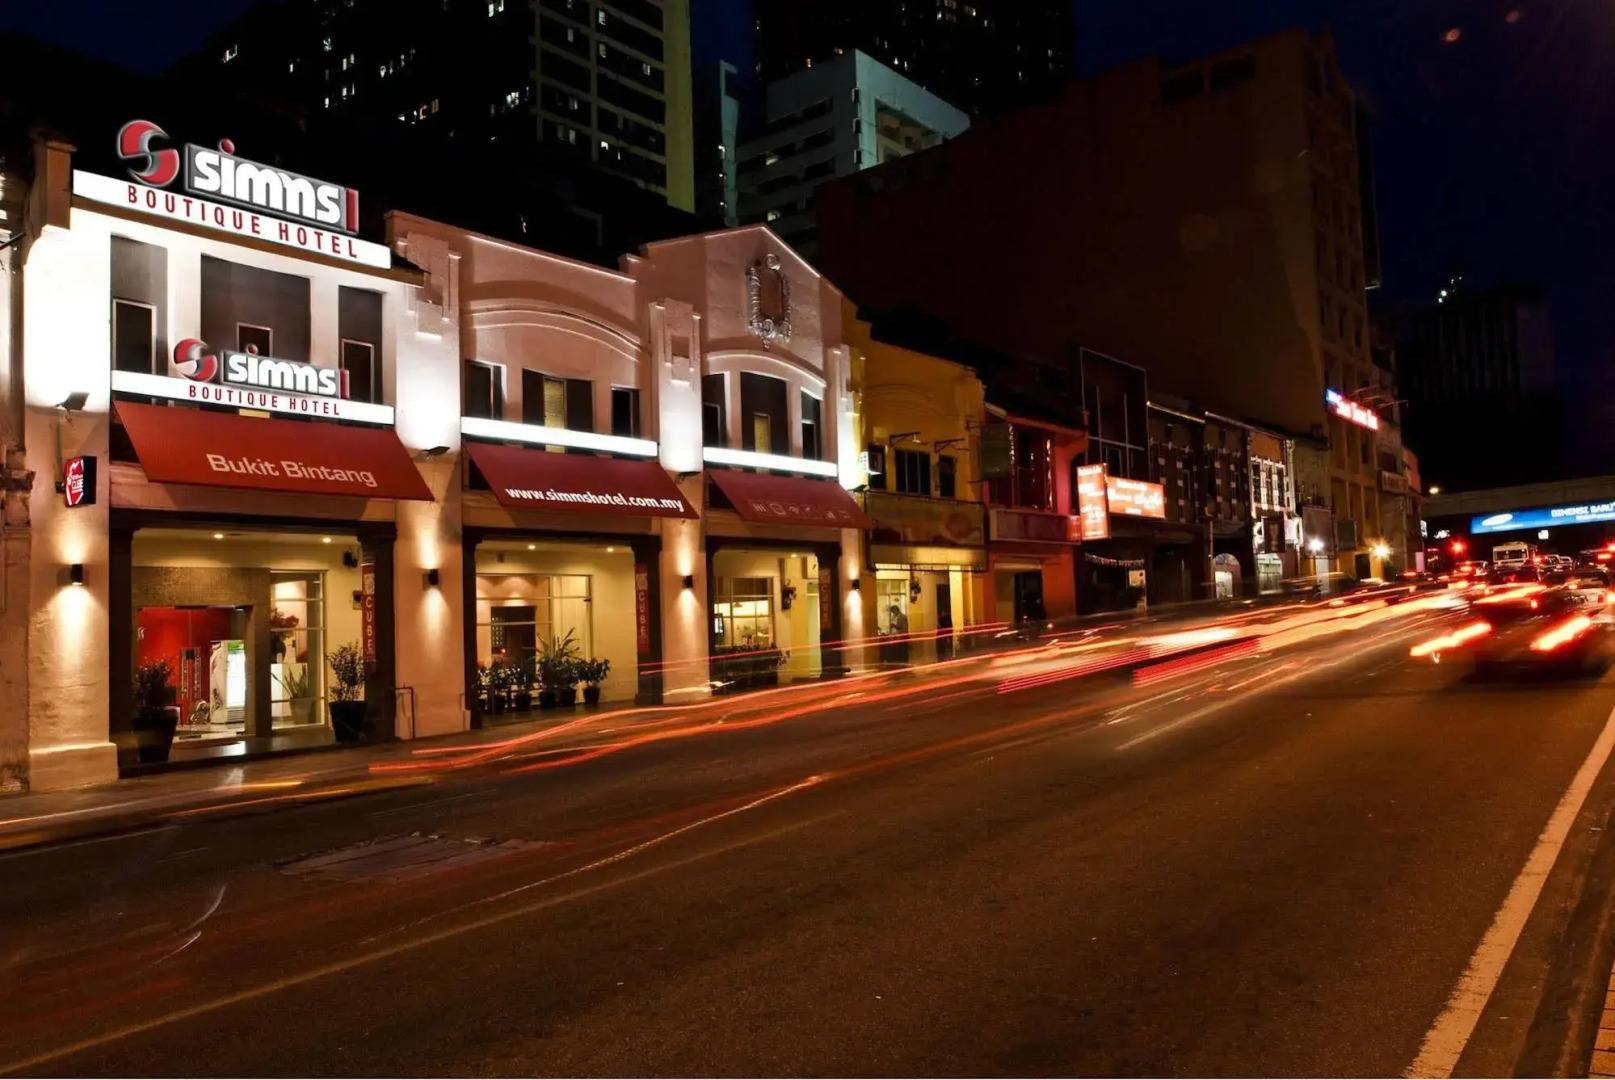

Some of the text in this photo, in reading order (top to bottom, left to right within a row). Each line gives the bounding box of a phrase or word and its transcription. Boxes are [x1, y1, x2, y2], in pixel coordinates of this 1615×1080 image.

[193, 138, 343, 225] simms
[127, 184, 358, 259] BOUTIQUE HOTEL
[227, 343, 337, 396] simms
[189, 384, 340, 416] BOUTIQUE HOTEL
[205, 453, 378, 488] Bukit Bintang
[504, 488, 686, 513] www.simmshotel.com.my
[365, 596, 374, 651] CUBE
